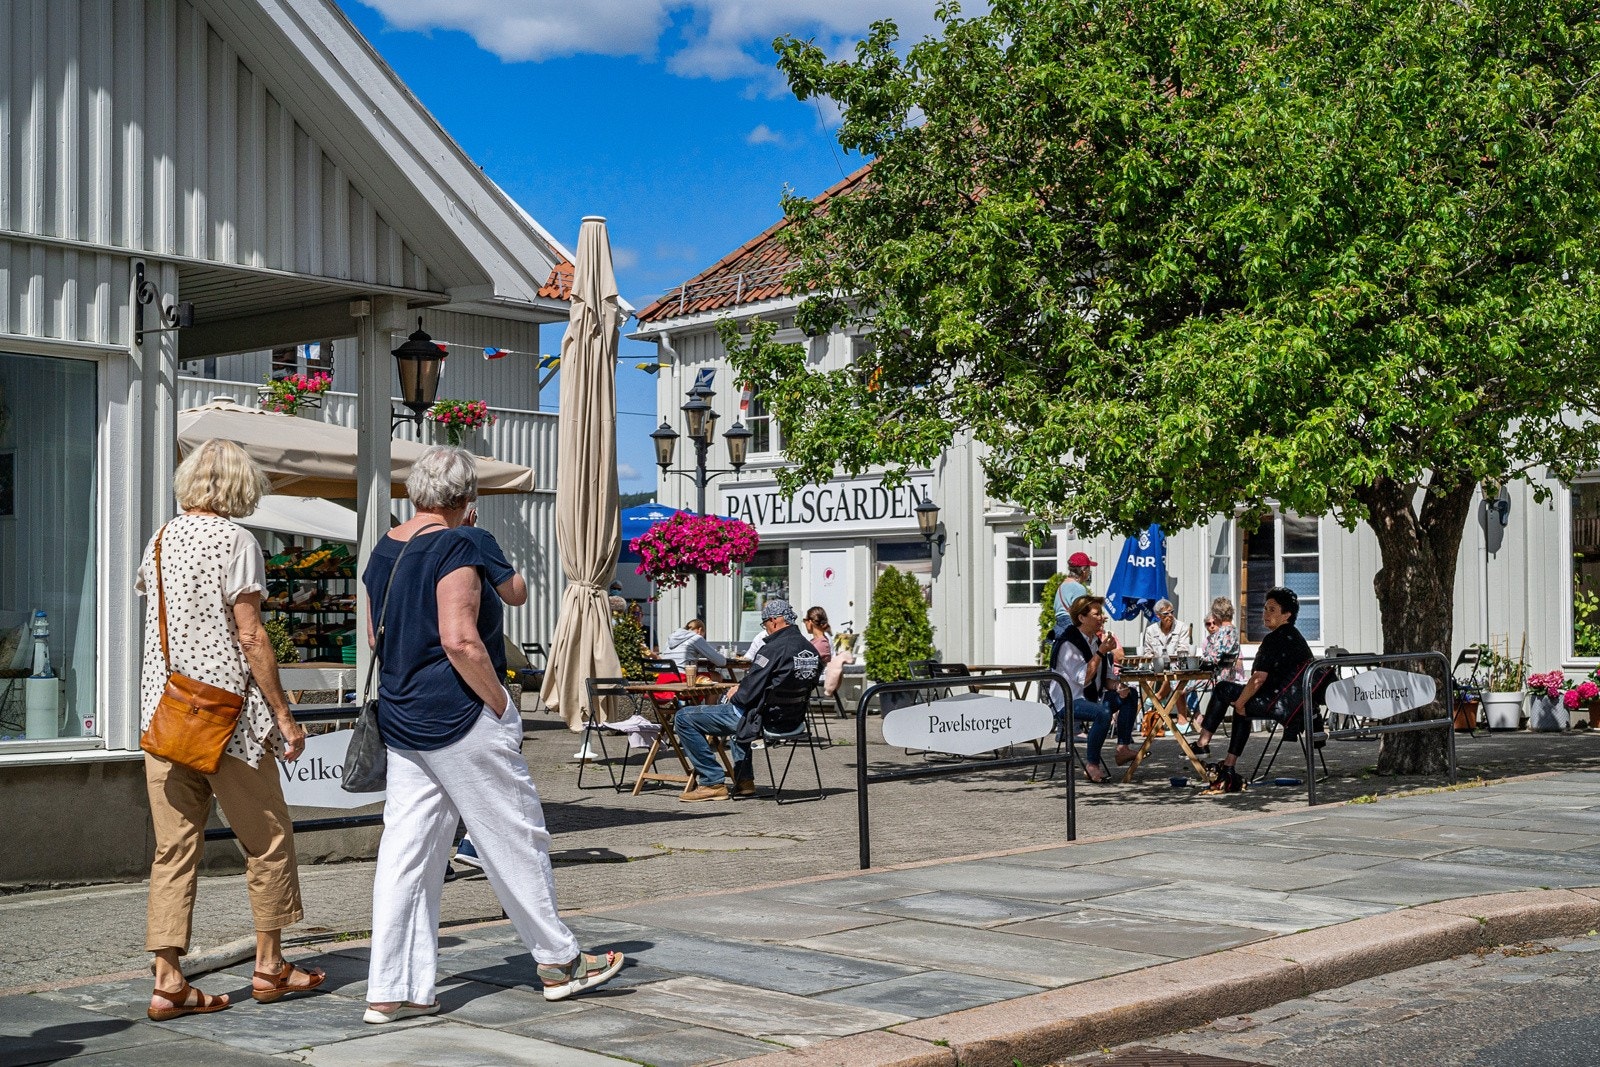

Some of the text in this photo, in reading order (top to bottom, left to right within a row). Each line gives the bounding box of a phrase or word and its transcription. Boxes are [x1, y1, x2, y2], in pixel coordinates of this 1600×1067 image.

[726, 483, 928, 526] PAVELSGÅRDEN
[1353, 685, 1409, 702] Pavelstorget
[928, 713, 1012, 734] Pavelstorget
